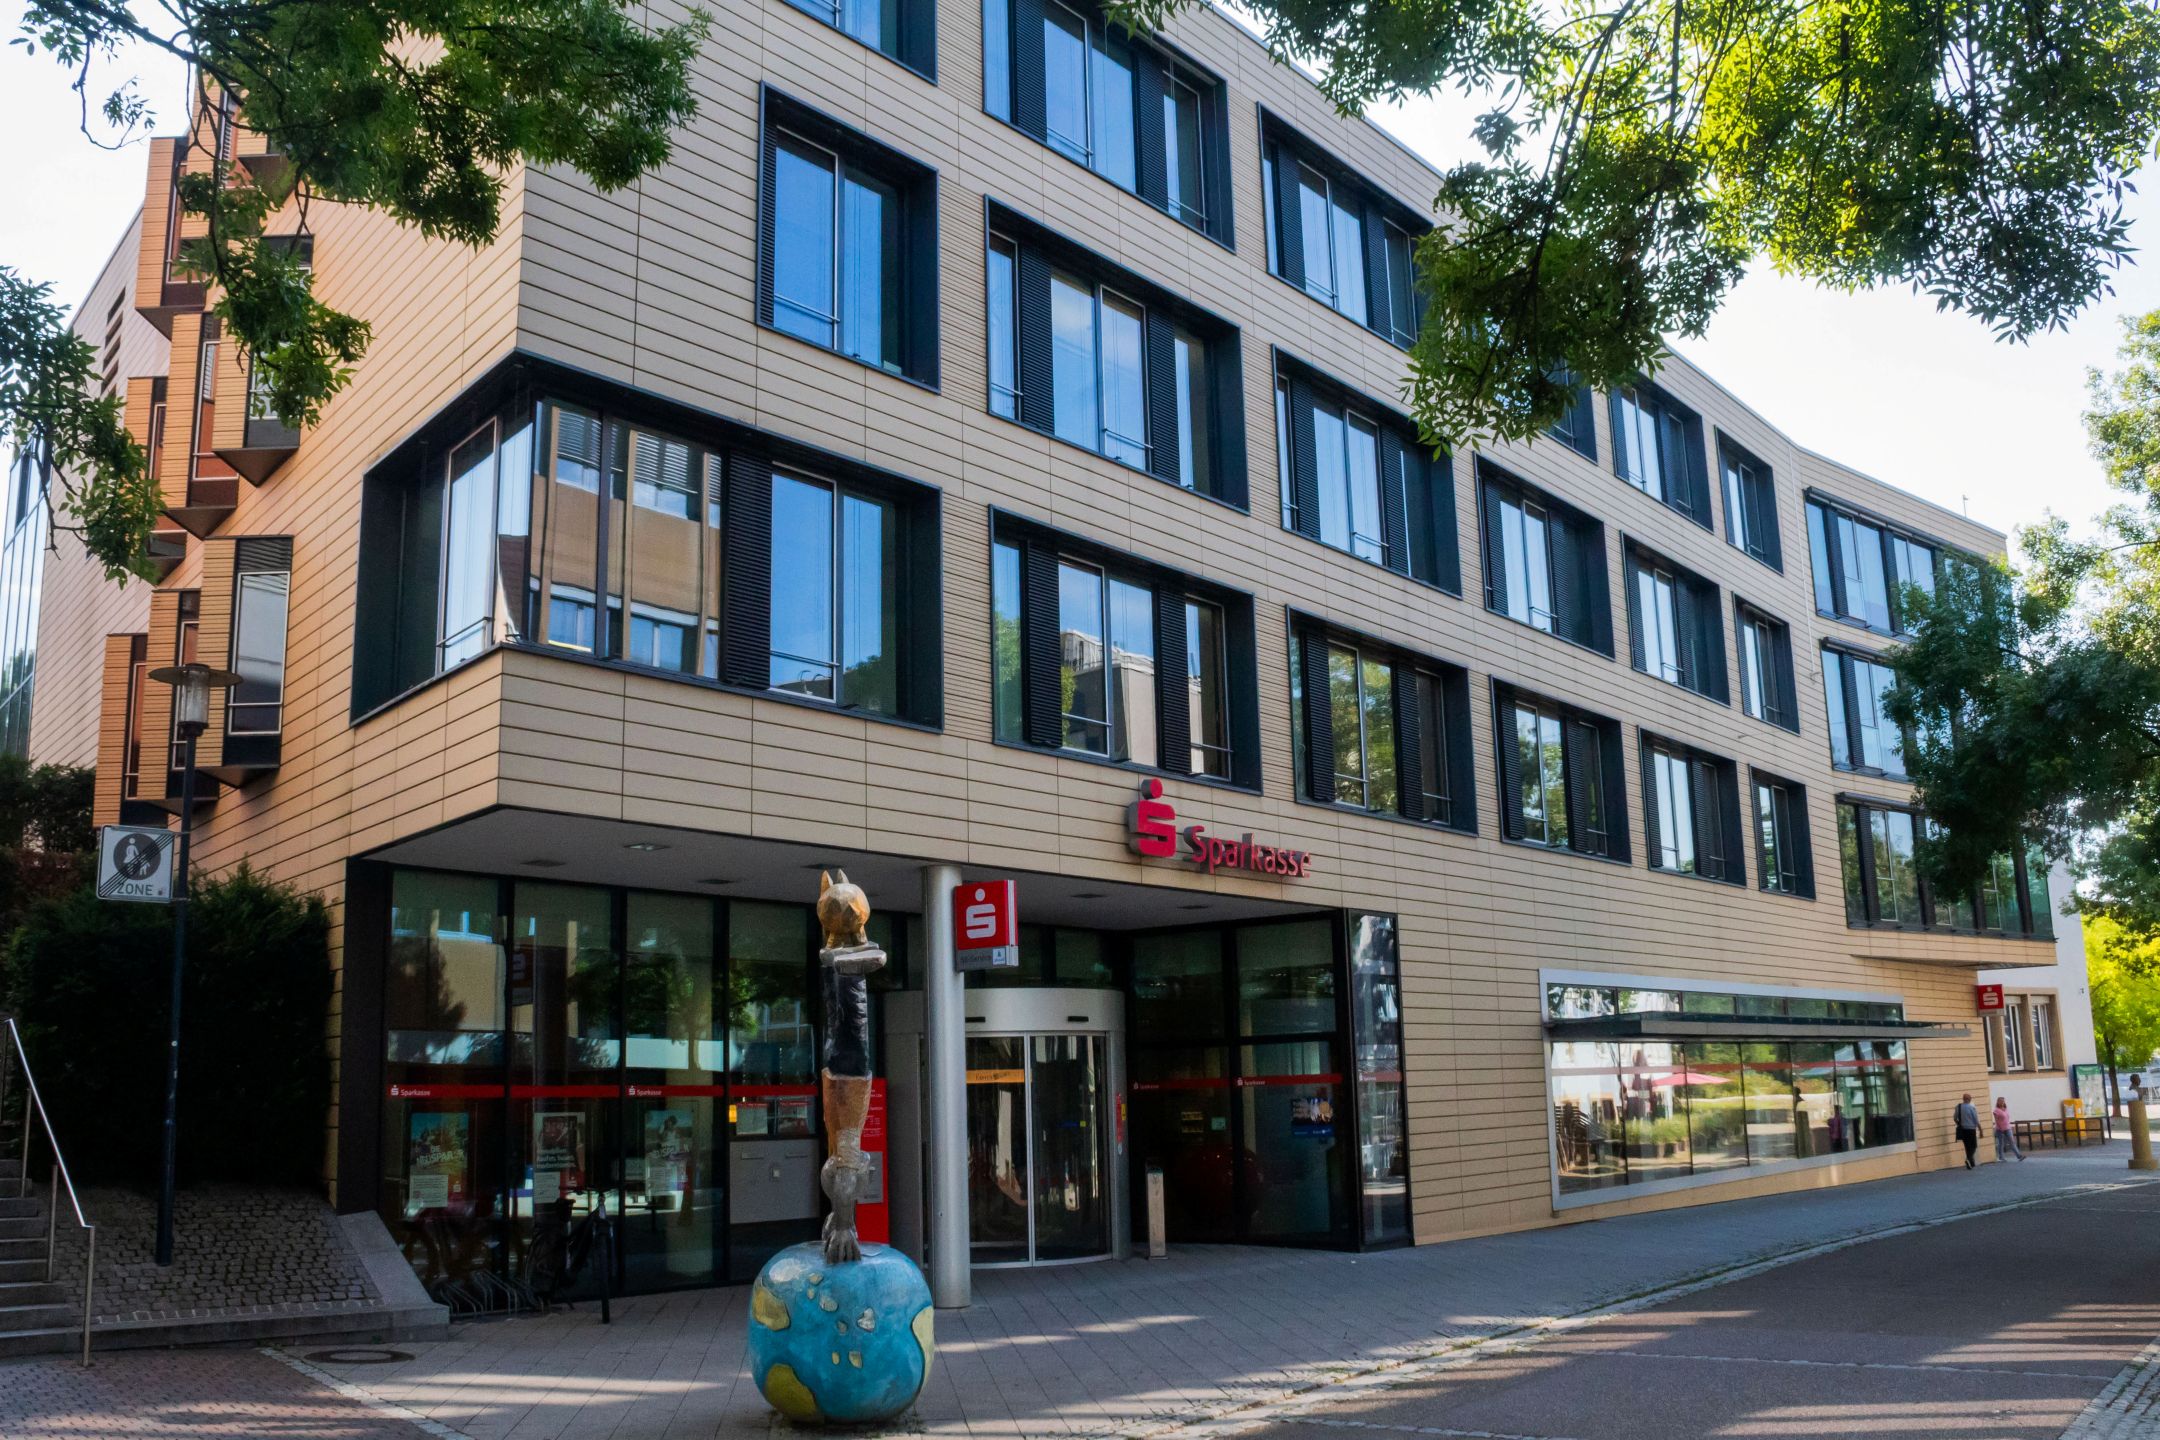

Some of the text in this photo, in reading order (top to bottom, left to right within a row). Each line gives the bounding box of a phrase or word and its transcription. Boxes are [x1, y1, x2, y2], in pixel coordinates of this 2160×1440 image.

[1185, 825, 1312, 878] Sparkasse
[116, 883, 154, 896] ZONE
[400, 1088, 431, 1097] Sparkasse
